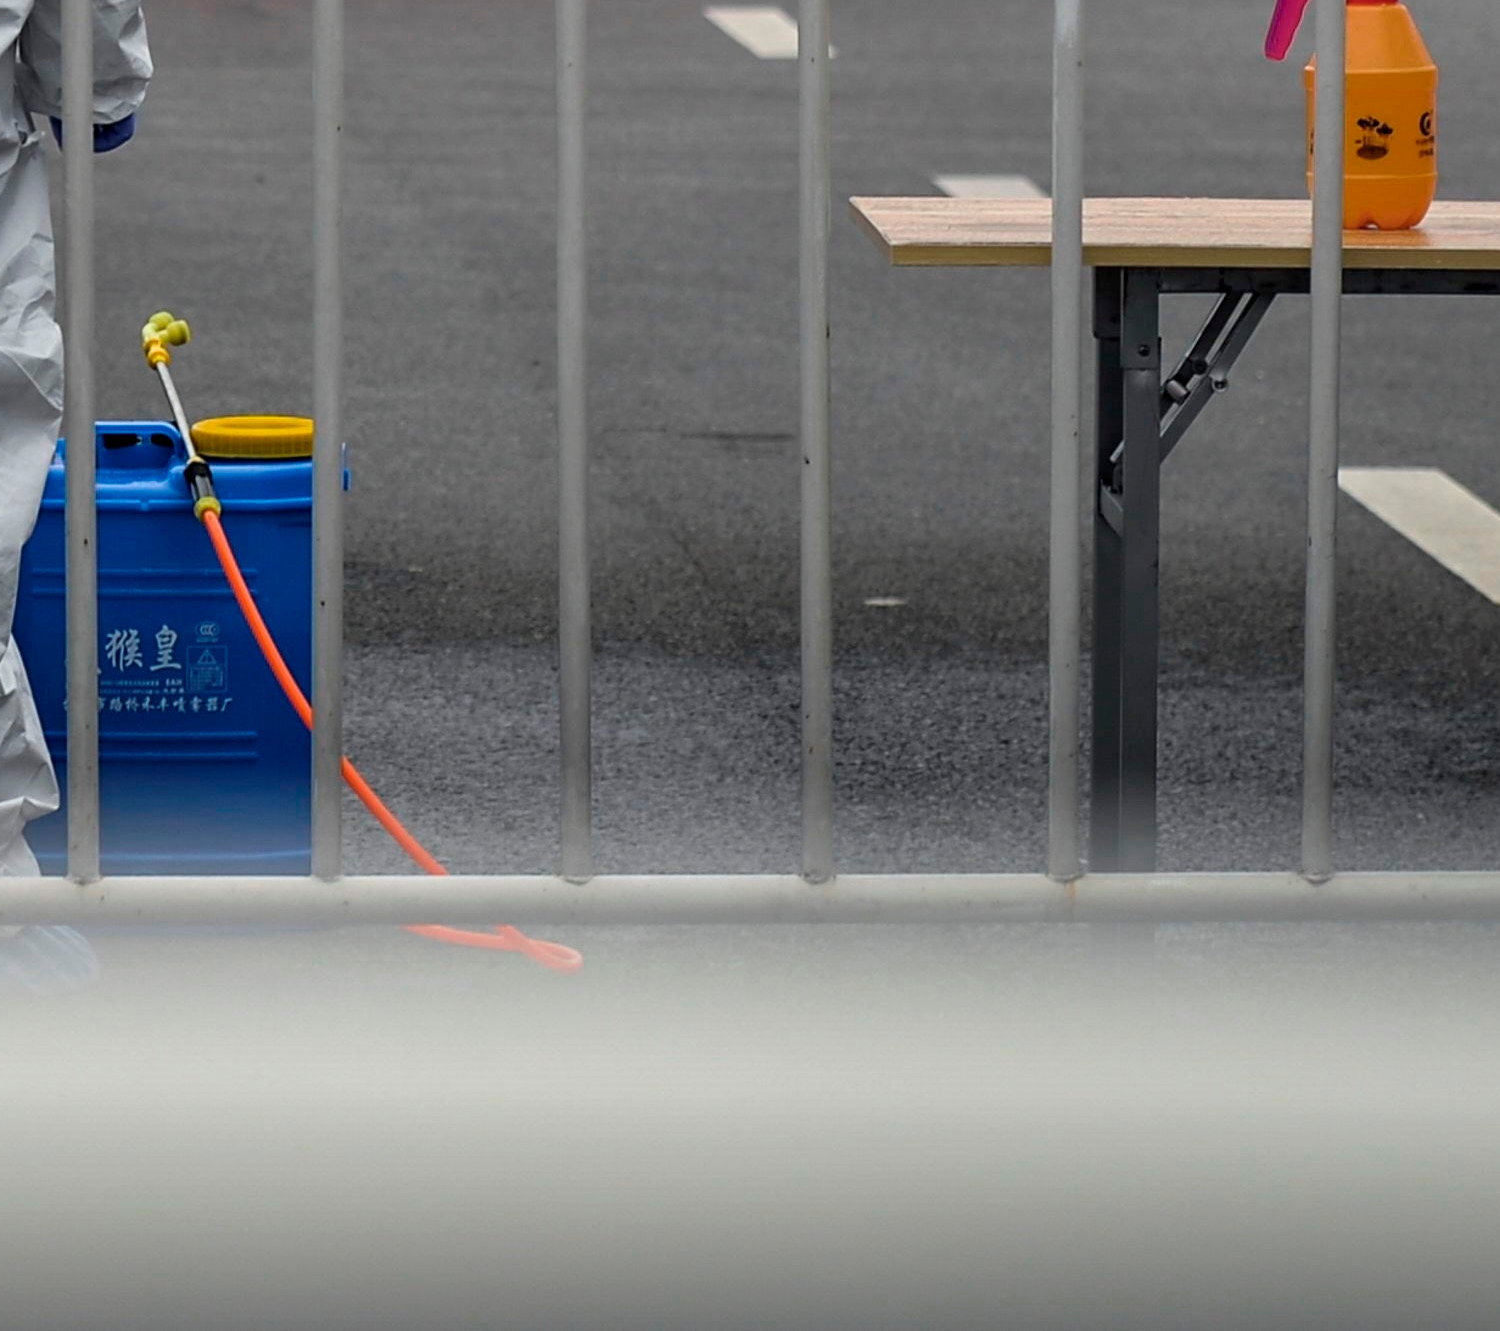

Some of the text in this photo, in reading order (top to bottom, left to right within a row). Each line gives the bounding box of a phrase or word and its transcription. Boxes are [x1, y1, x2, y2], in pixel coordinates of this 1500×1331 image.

[97, 624, 182, 673] 猴皇
[63, 696, 233, 713] 市路桥禾丰喷雾器厂
